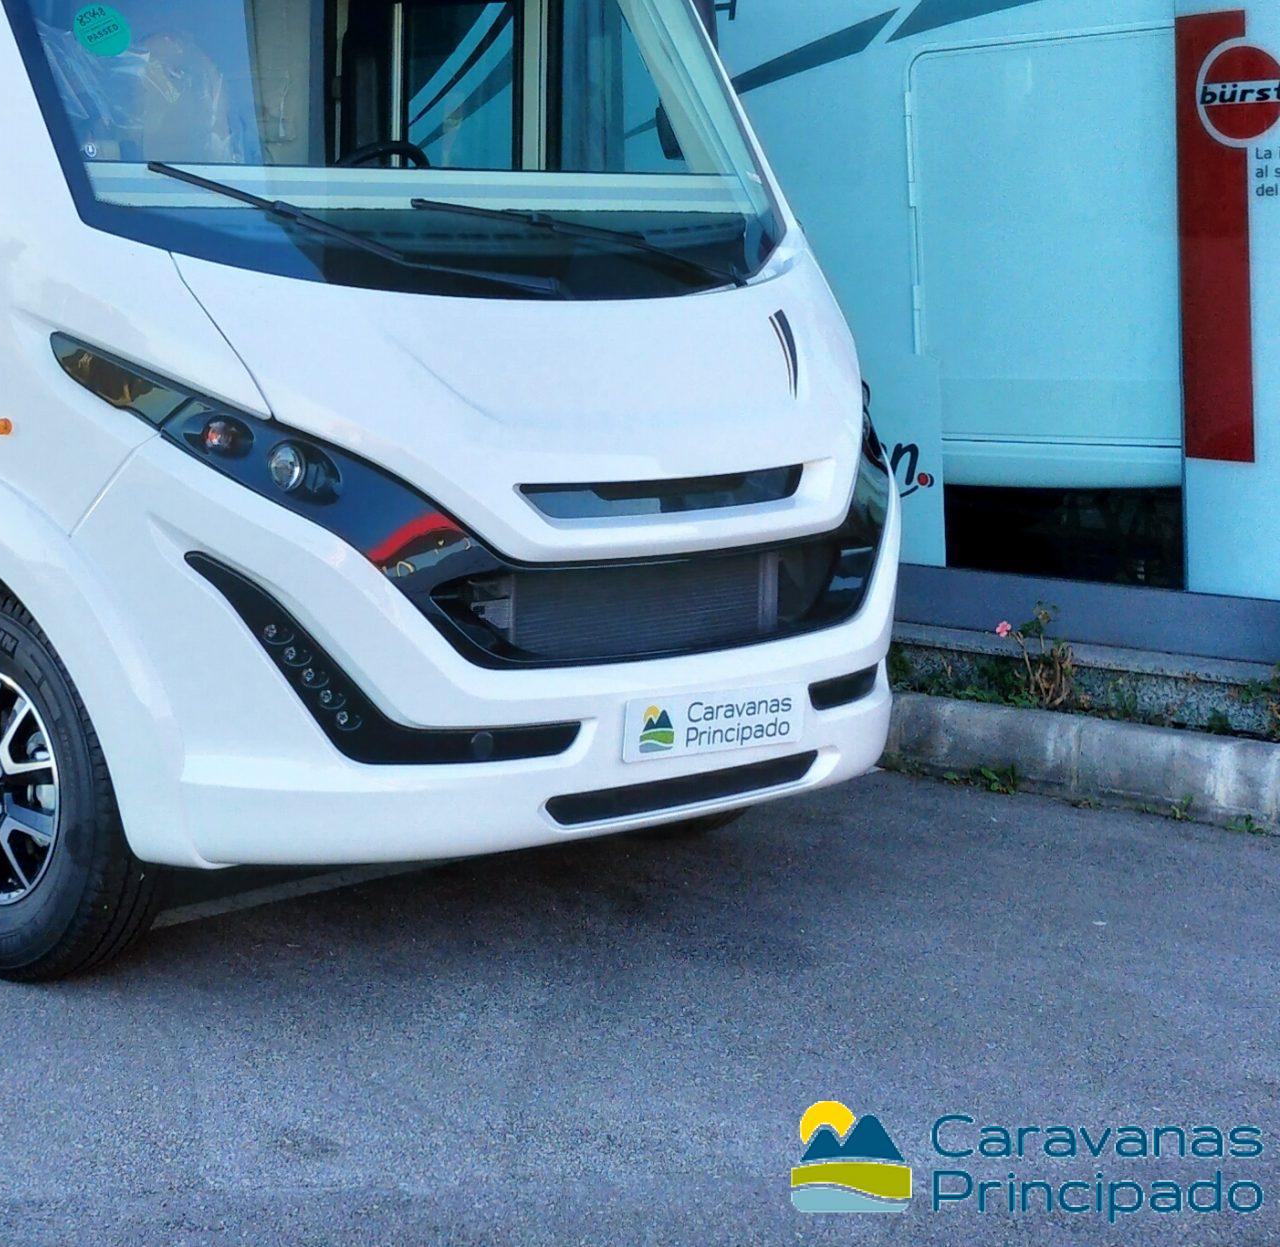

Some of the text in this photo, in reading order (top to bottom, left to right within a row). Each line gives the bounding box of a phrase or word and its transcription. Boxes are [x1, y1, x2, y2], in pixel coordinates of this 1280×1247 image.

[87, 23, 118, 43] PASSED
[1255, 147, 1272, 160] La
[1255, 165, 1268, 178] al
[1255, 183, 1278, 196] del
[688, 697, 792, 723] Caravanas
[685, 718, 790, 748] Principado
